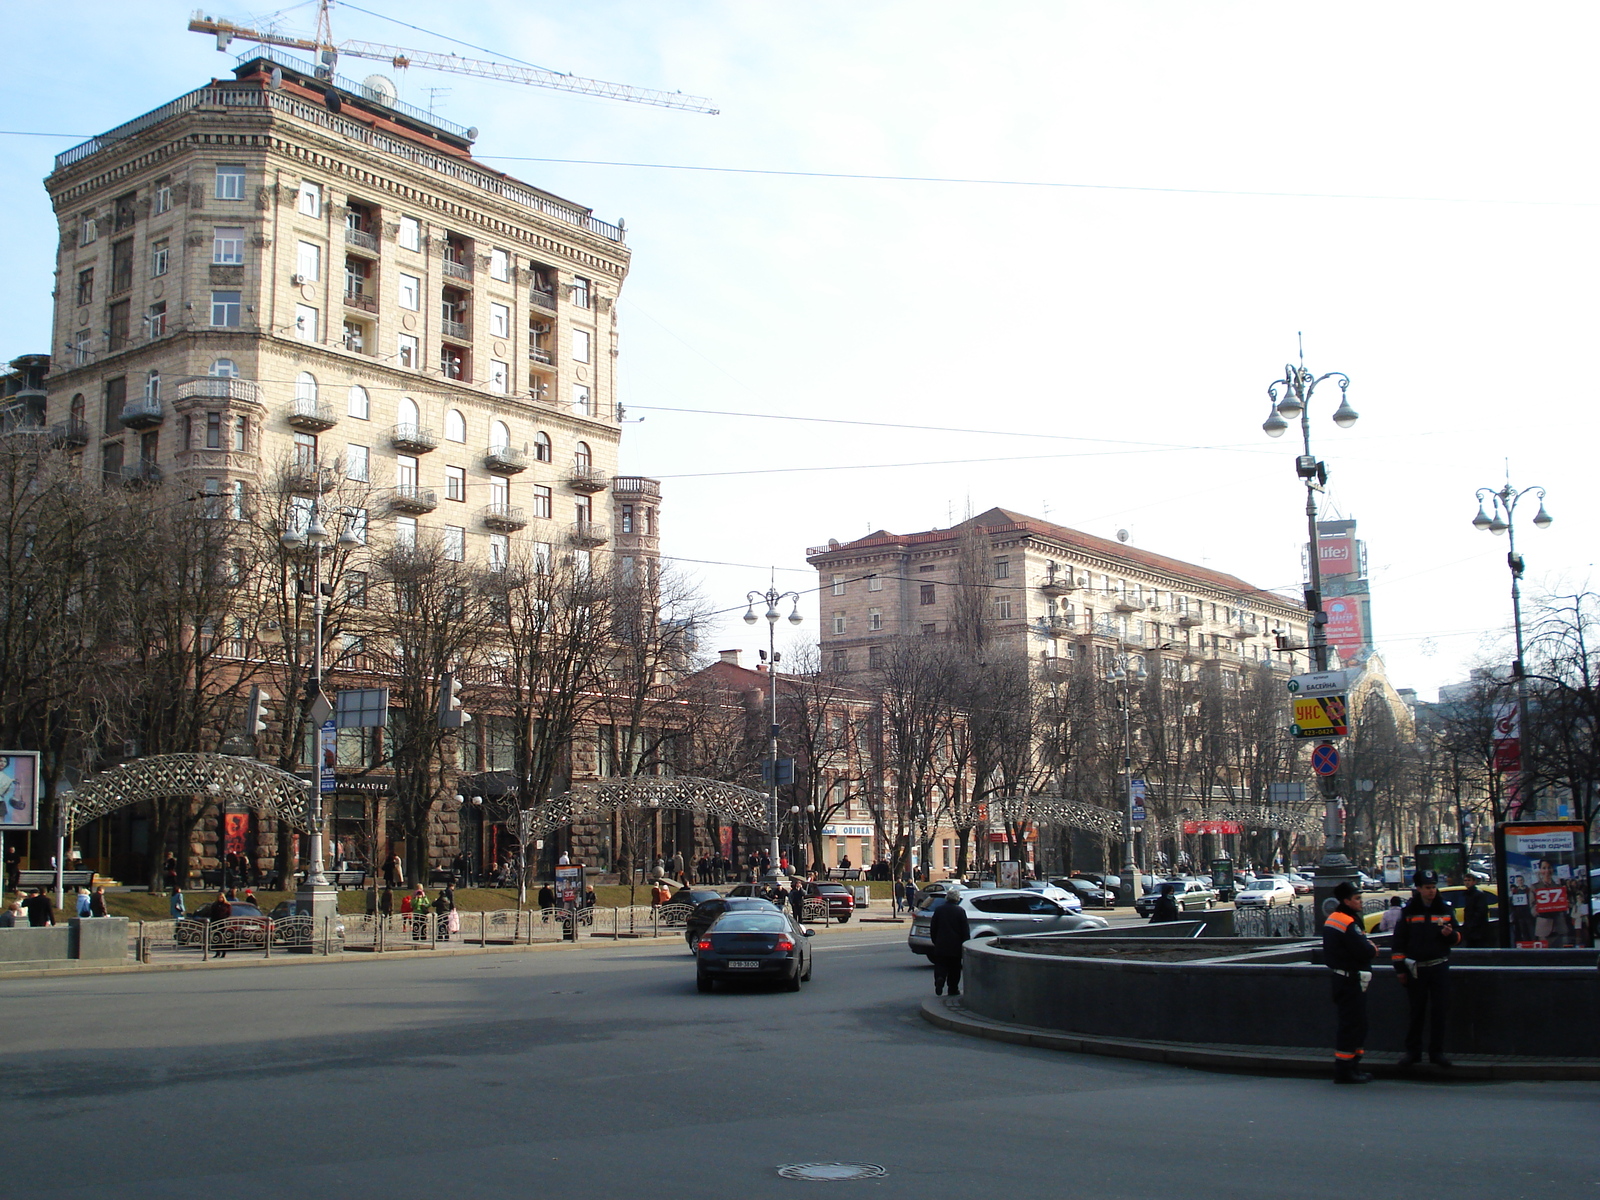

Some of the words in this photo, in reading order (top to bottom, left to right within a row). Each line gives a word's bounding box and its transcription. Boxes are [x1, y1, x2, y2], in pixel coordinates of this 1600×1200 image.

[1320, 546, 1349, 560] life:)
[1306, 682, 1337, 690] БАСЕЙНА
[1296, 705, 1321, 720] УКС
[843, 826, 870, 834] ОПТИКА
[1536, 888, 1563, 904] 37
